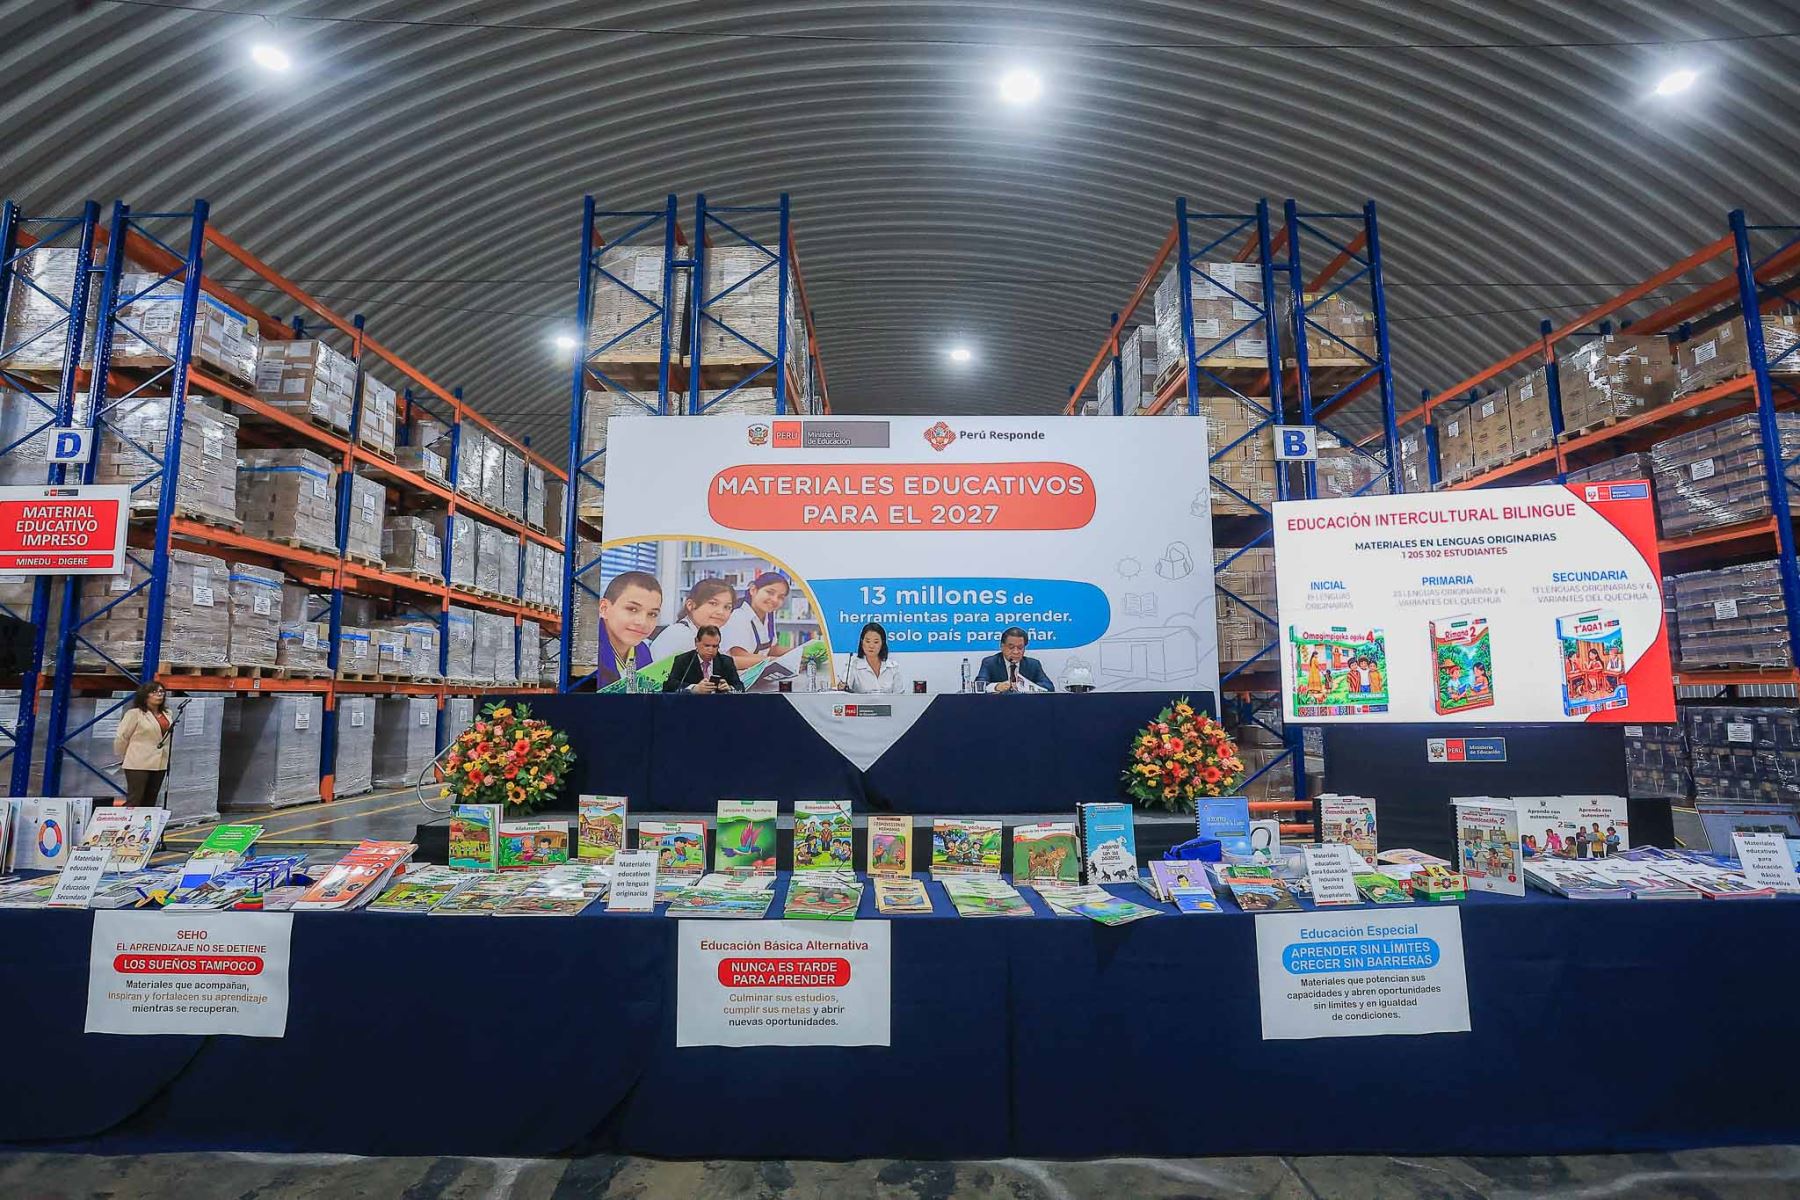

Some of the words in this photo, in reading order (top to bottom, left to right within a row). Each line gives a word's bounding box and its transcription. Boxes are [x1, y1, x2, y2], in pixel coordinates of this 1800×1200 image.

[959, 429, 986, 440] Perú
[989, 430, 1045, 442] Responde
[56, 432, 81, 458] D
[1283, 430, 1308, 456] B
[717, 475, 895, 496] MATERIALES
[903, 474, 1086, 496] EDUCATIVOS
[23, 506, 94, 518] MATERIAL
[803, 504, 880, 524] PARA
[888, 504, 922, 524] EL
[930, 504, 1000, 524] 2027
[1288, 513, 1371, 531] EDUCACIÓN
[1376, 507, 1498, 527] INTERCULTURAL
[1502, 503, 1576, 520] BILINGUE
[16, 520, 98, 532] EDUCATIVO
[22, 534, 88, 546] IMPRESO
[1355, 539, 1417, 550] MATERIALES
[1420, 538, 1434, 548] EN
[1436, 536, 1484, 547] LENGUAS
[1487, 533, 1557, 545] ORIGINARIAS
[1444, 547, 1508, 558] ESTUDIANTES
[16, 558, 51, 566] MINEDU
[58, 557, 88, 566] DIGERE
[1422, 576, 1474, 586] PRIMARIA
[1552, 570, 1628, 582] SECUNDARIA
[1310, 580, 1346, 590] INICIAL
[860, 585, 887, 605] 13
[896, 585, 1008, 606] millones
[1013, 592, 1034, 605] de
[840, 610, 948, 623] herramientas
[953, 612, 990, 626] para
[994, 610, 1073, 626] aprender.
[888, 629, 923, 642] solo
[928, 628, 961, 644] país
[966, 631, 1002, 644] para
[1366, 630, 1374, 642] 4
[176, 930, 208, 940] SEHO
[1300, 926, 1364, 940] Educación
[1367, 924, 1418, 939] Especial
[116, 943, 128, 951] EL
[130, 943, 192, 952] APRENDIZAJE
[197, 944, 210, 952] NO
[212, 944, 224, 953] SE
[226, 945, 266, 954] DETIENE
[700, 940, 760, 951] Educación
[764, 940, 803, 951] Básica
[806, 940, 868, 951] Alternativa
[1291, 944, 1358, 958] APRENDER
[1360, 944, 1380, 954] SIN
[1384, 941, 1431, 954] LÍMITES
[124, 959, 146, 970] LOS
[148, 957, 197, 970] SUEÑOS
[199, 960, 256, 972] TAMPOCO
[731, 962, 776, 973] NUNCA
[778, 962, 794, 972] ES
[797, 962, 838, 972] TARDE
[1291, 959, 1340, 971] CRECER
[1344, 958, 1364, 968] SIN
[1367, 954, 1432, 968] BARRERAS
[734, 974, 766, 985] PARA
[768, 974, 836, 985] APRENDER
[1301, 977, 1346, 986] Materiales
[1348, 978, 1364, 986] que
[1366, 974, 1410, 985] potencian
[126, 980, 172, 989] Materiales
[176, 982, 192, 991] que
[194, 981, 250, 992] acompañan,
[144, 994, 150, 1002] y
[152, 991, 199, 1001] fortalecen
[216, 992, 268, 1005] aprendizaje
[730, 993, 774, 1002] Culminar
[795, 993, 838, 1004] estudios,
[1287, 988, 1342, 1000] capacidades
[1344, 990, 1350, 998] y
[1352, 987, 1376, 996] abren
[1378, 985, 1441, 997] oportunidades
[132, 1004, 174, 1013] mientras
[189, 1005, 240, 1016] recuperan.
[724, 1005, 760, 1016] cumplir
[782, 1006, 810, 1014] metas
[813, 1007, 819, 1016] y
[821, 1004, 844, 1014] abrir
[1314, 1001, 1327, 1010] sin
[1359, 1002, 1364, 1010] y
[1378, 998, 1418, 1010] igualdad
[1332, 1012, 1344, 1021] de
[1345, 1010, 1400, 1021] condiciones.
[729, 1018, 763, 1026] nuevas
[766, 1016, 838, 1028] oportunidades.
